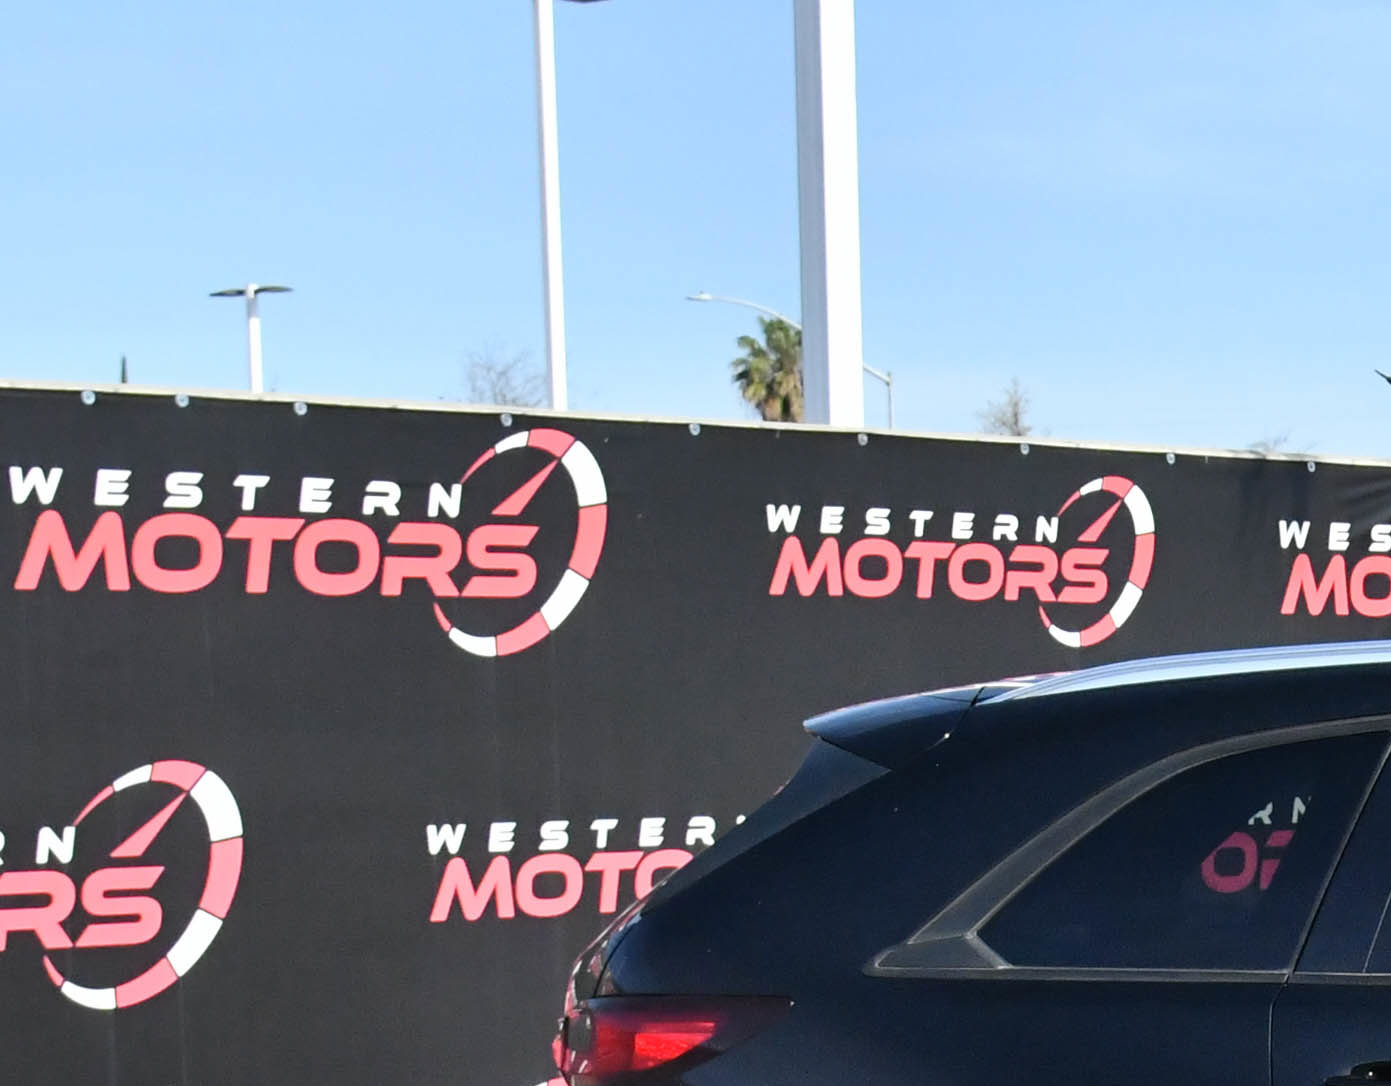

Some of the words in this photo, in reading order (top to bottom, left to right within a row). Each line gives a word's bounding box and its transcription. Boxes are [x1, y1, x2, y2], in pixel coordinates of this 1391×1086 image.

[9, 466, 463, 517] WESTERN
[766, 504, 1062, 543] WESTERN
[13, 510, 540, 598] MOTORS
[768, 536, 1110, 603] MOTORS
[425, 814, 747, 856] WESTER
